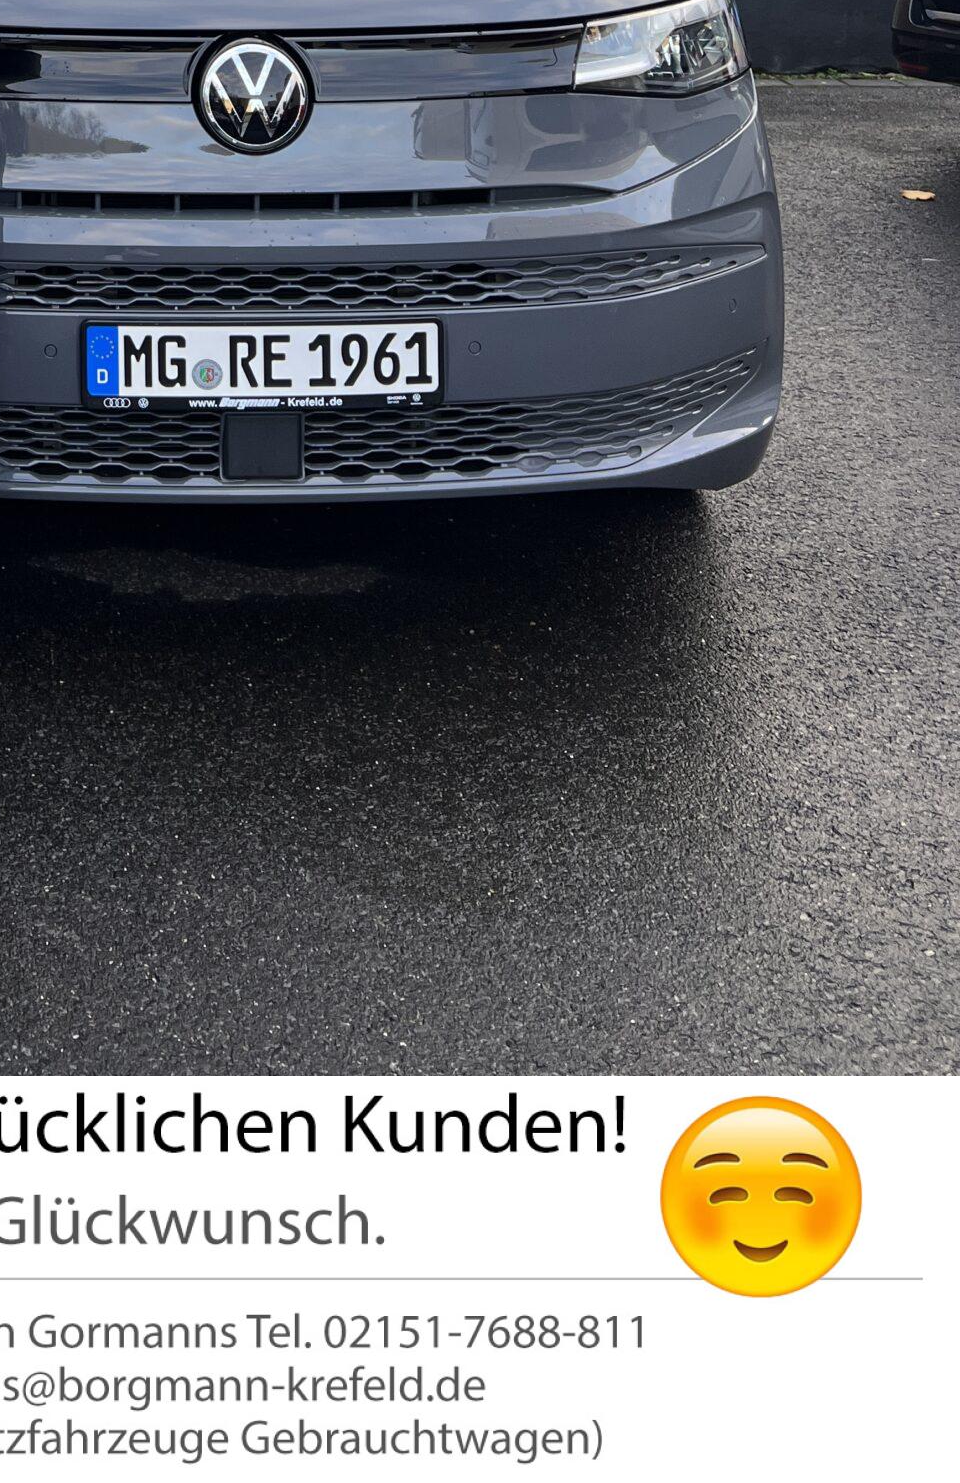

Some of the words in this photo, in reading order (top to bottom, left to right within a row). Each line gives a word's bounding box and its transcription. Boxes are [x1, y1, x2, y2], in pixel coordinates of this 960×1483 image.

[96, 369, 108, 384] D
[123, 334, 187, 388] MG
[229, 334, 293, 388] RE
[308, 331, 433, 388] 1961
